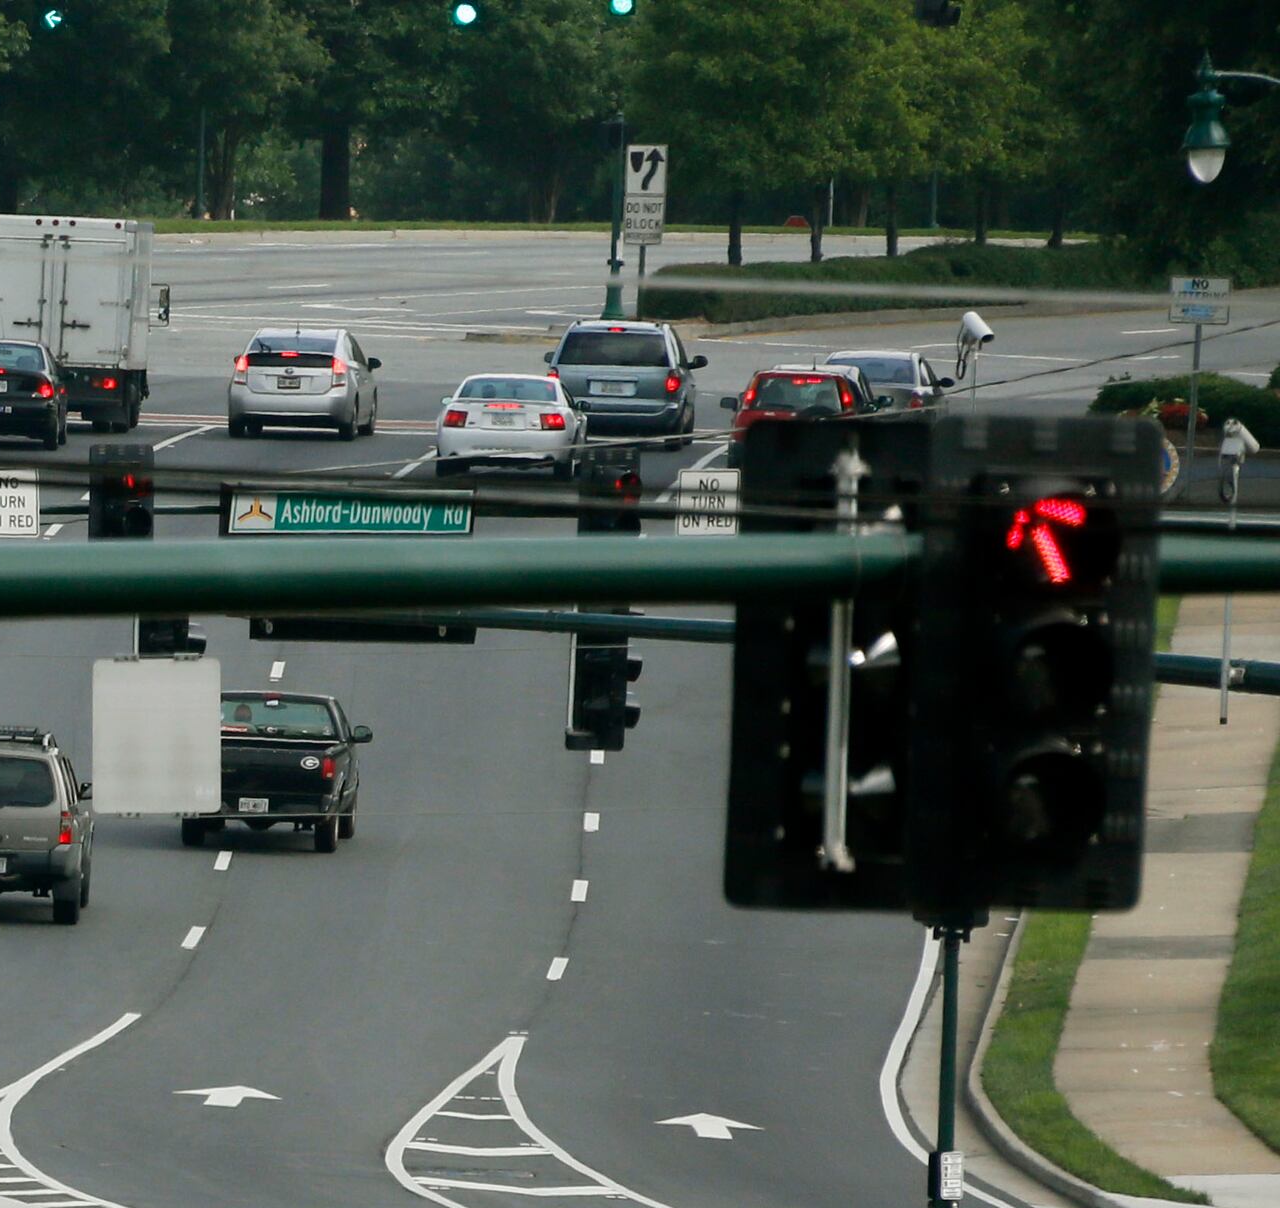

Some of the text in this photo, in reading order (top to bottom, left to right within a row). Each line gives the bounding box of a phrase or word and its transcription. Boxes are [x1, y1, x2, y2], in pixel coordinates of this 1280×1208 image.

[626, 202, 640, 213] DO
[626, 218, 661, 229] BLOCK
[1192, 278, 1209, 290] NO
[699, 478, 720, 492] NO
[691, 495, 726, 509] TURN
[9, 514, 34, 528] RED
[280, 499, 464, 530] Ashford-Dunwoody Rd
[682, 515, 733, 528] ON RED
